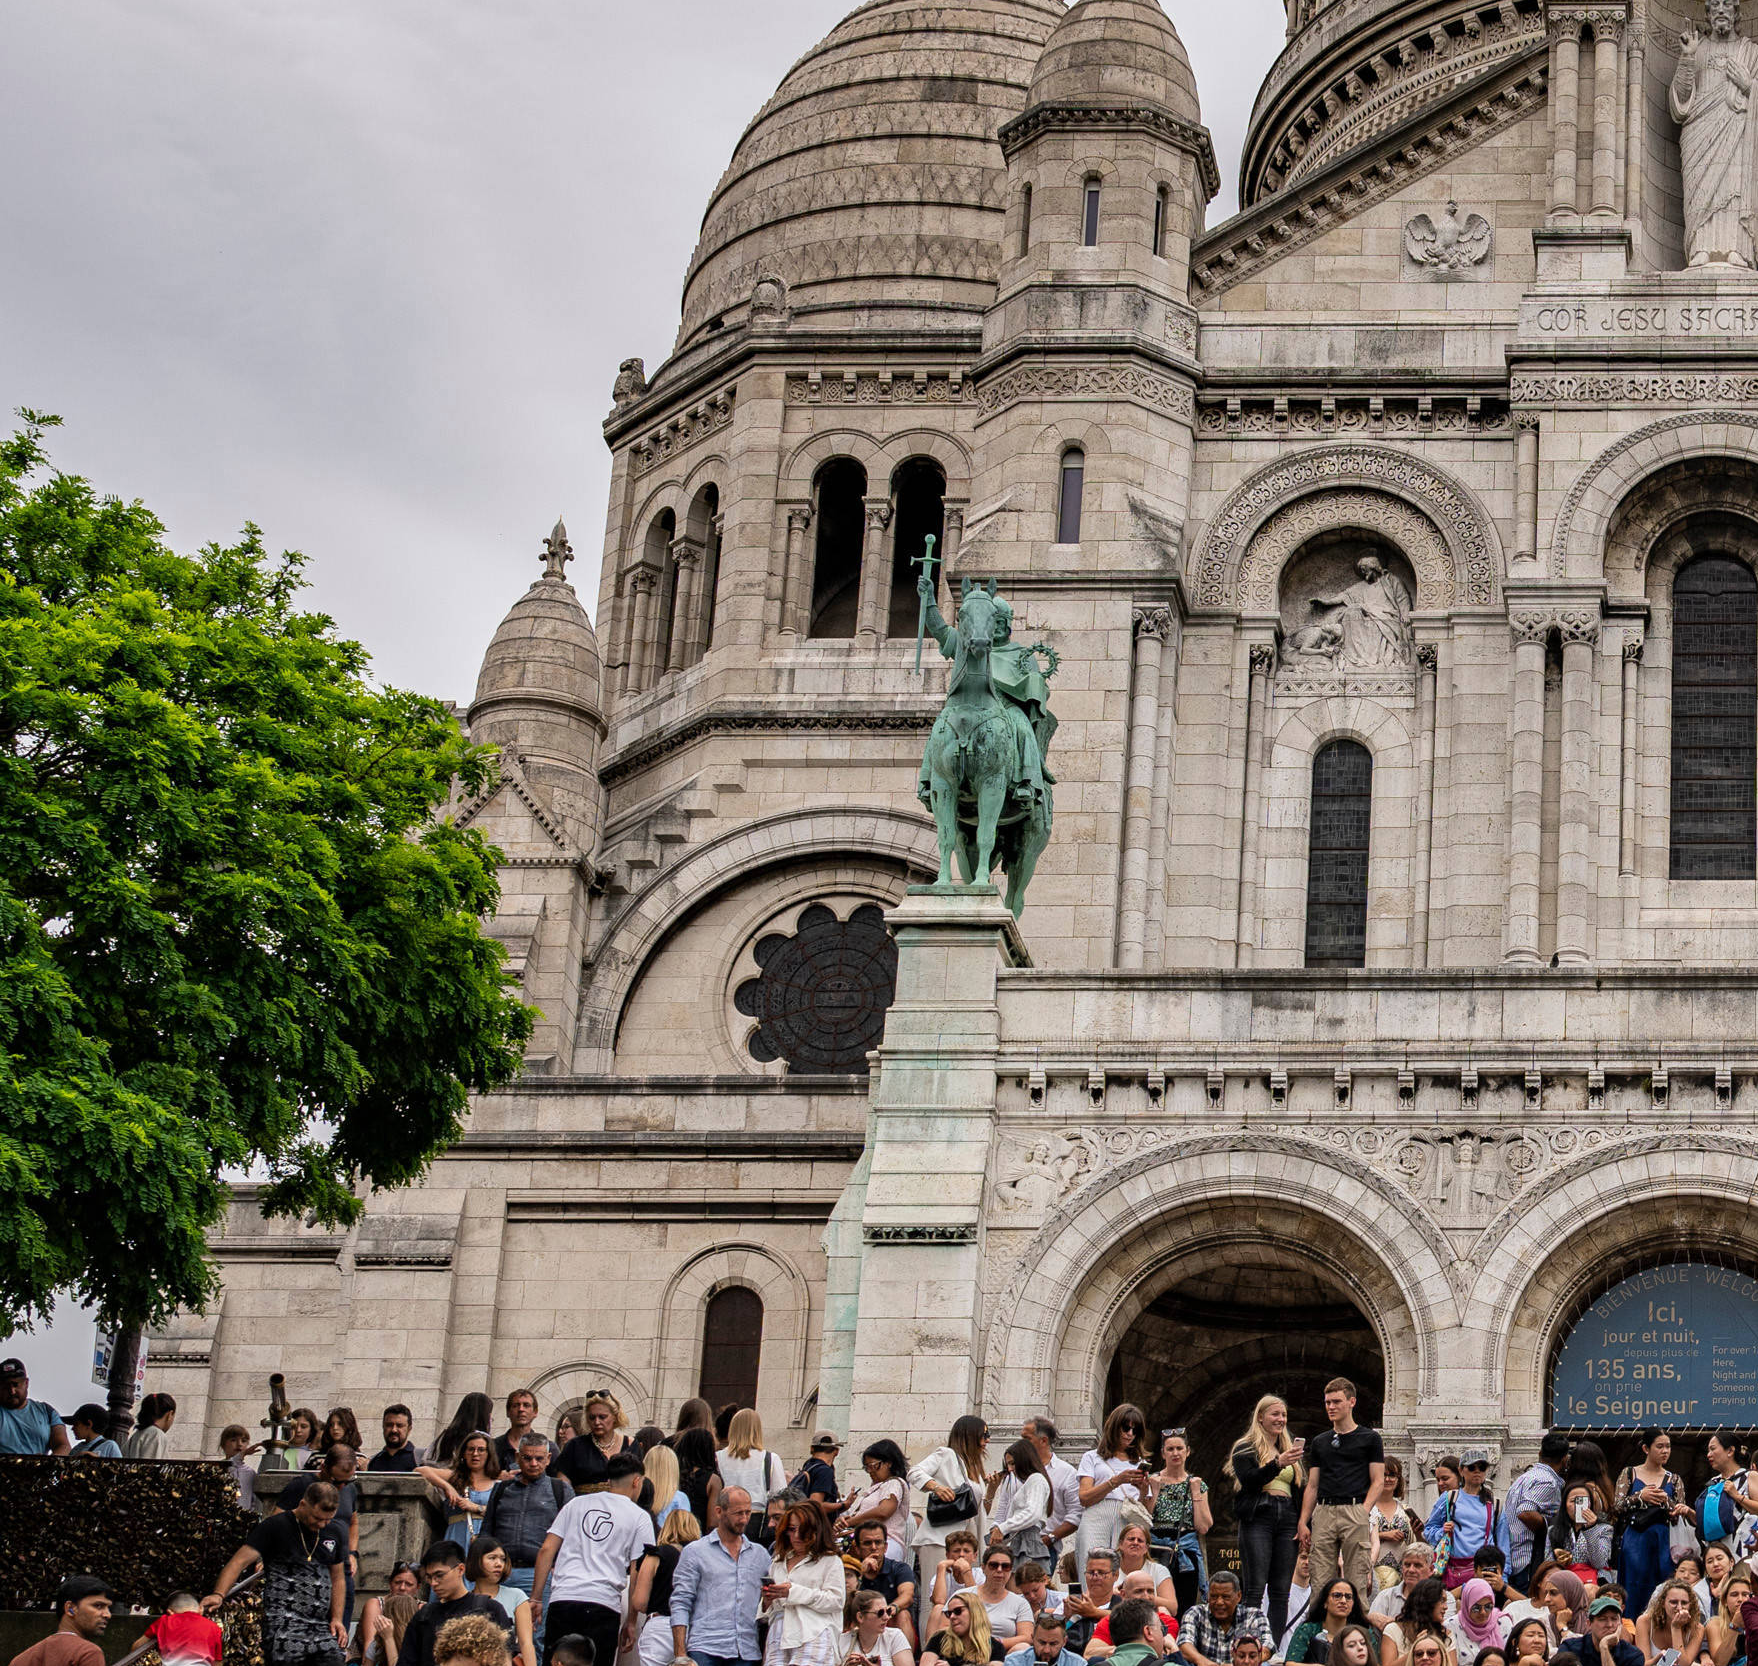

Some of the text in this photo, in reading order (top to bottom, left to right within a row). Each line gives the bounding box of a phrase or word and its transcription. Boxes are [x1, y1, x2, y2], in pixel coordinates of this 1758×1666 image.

[1537, 307, 1588, 331] COR
[1601, 307, 1667, 331] JESU
[1595, 1268, 1689, 1319] BIENVENUE
[1648, 1300, 1684, 1326] Ici,
[1603, 1329, 1700, 1347] jour et nuit,
[1623, 1347, 1658, 1359] depuis
[1712, 1345, 1728, 1355] For
[1730, 1347, 1750, 1355] over
[1712, 1358, 1737, 1368] Here,
[1585, 1359, 1682, 1382] 135 ans,
[1712, 1370, 1737, 1382] Night
[1739, 1370, 1756, 1380] and
[1595, 1381, 1642, 1395] on prie
[1712, 1383, 1755, 1392] Someone
[1568, 1396, 1699, 1420] le Seigneur
[1712, 1396, 1746, 1406] praying
[1748, 1396, 1757, 1404] to
